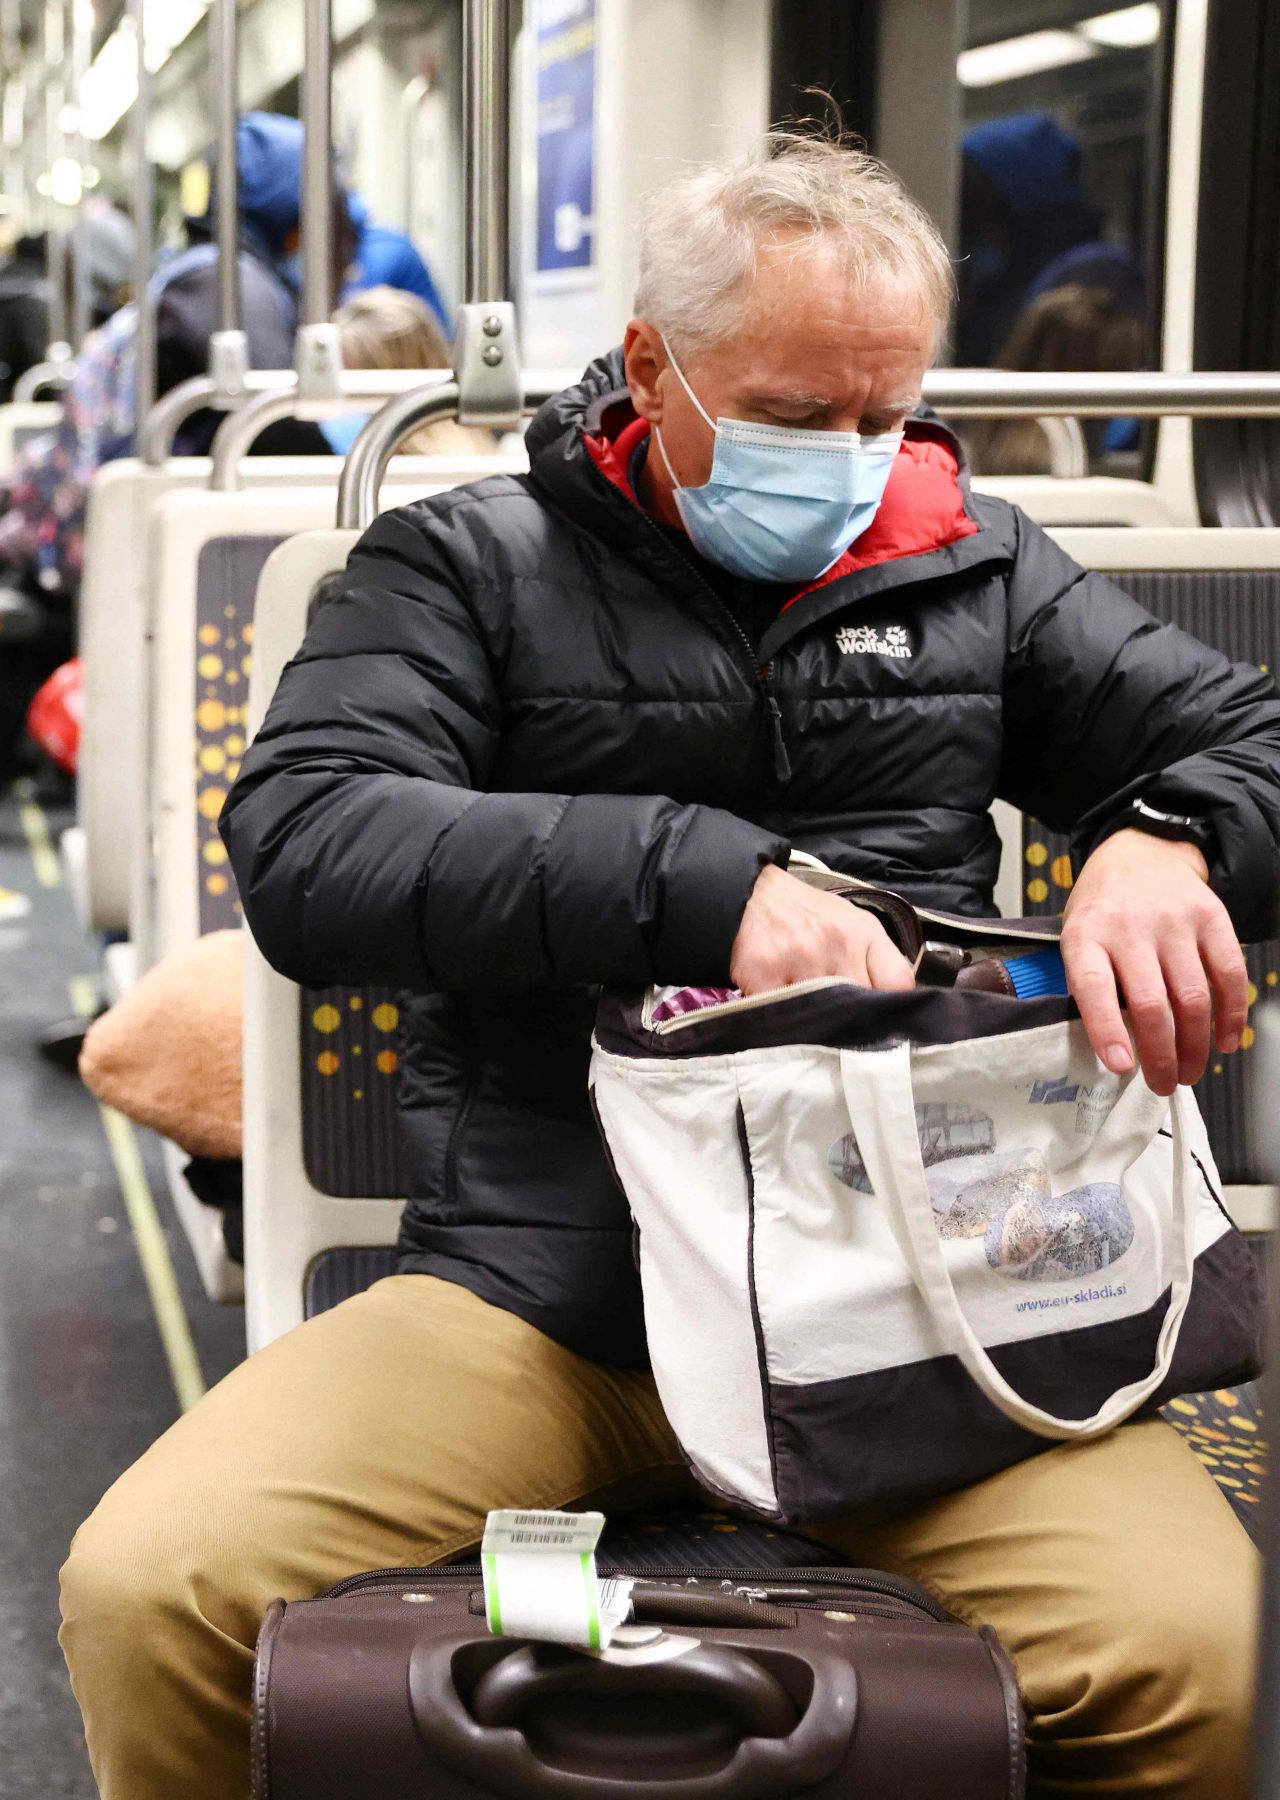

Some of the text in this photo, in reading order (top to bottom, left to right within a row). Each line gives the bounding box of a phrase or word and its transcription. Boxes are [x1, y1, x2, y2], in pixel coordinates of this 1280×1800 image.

[835, 625, 878, 639] Jack
[836, 638, 912, 658] Wolfskin
[1016, 1283, 1127, 1312] www.eu-skladi.si
